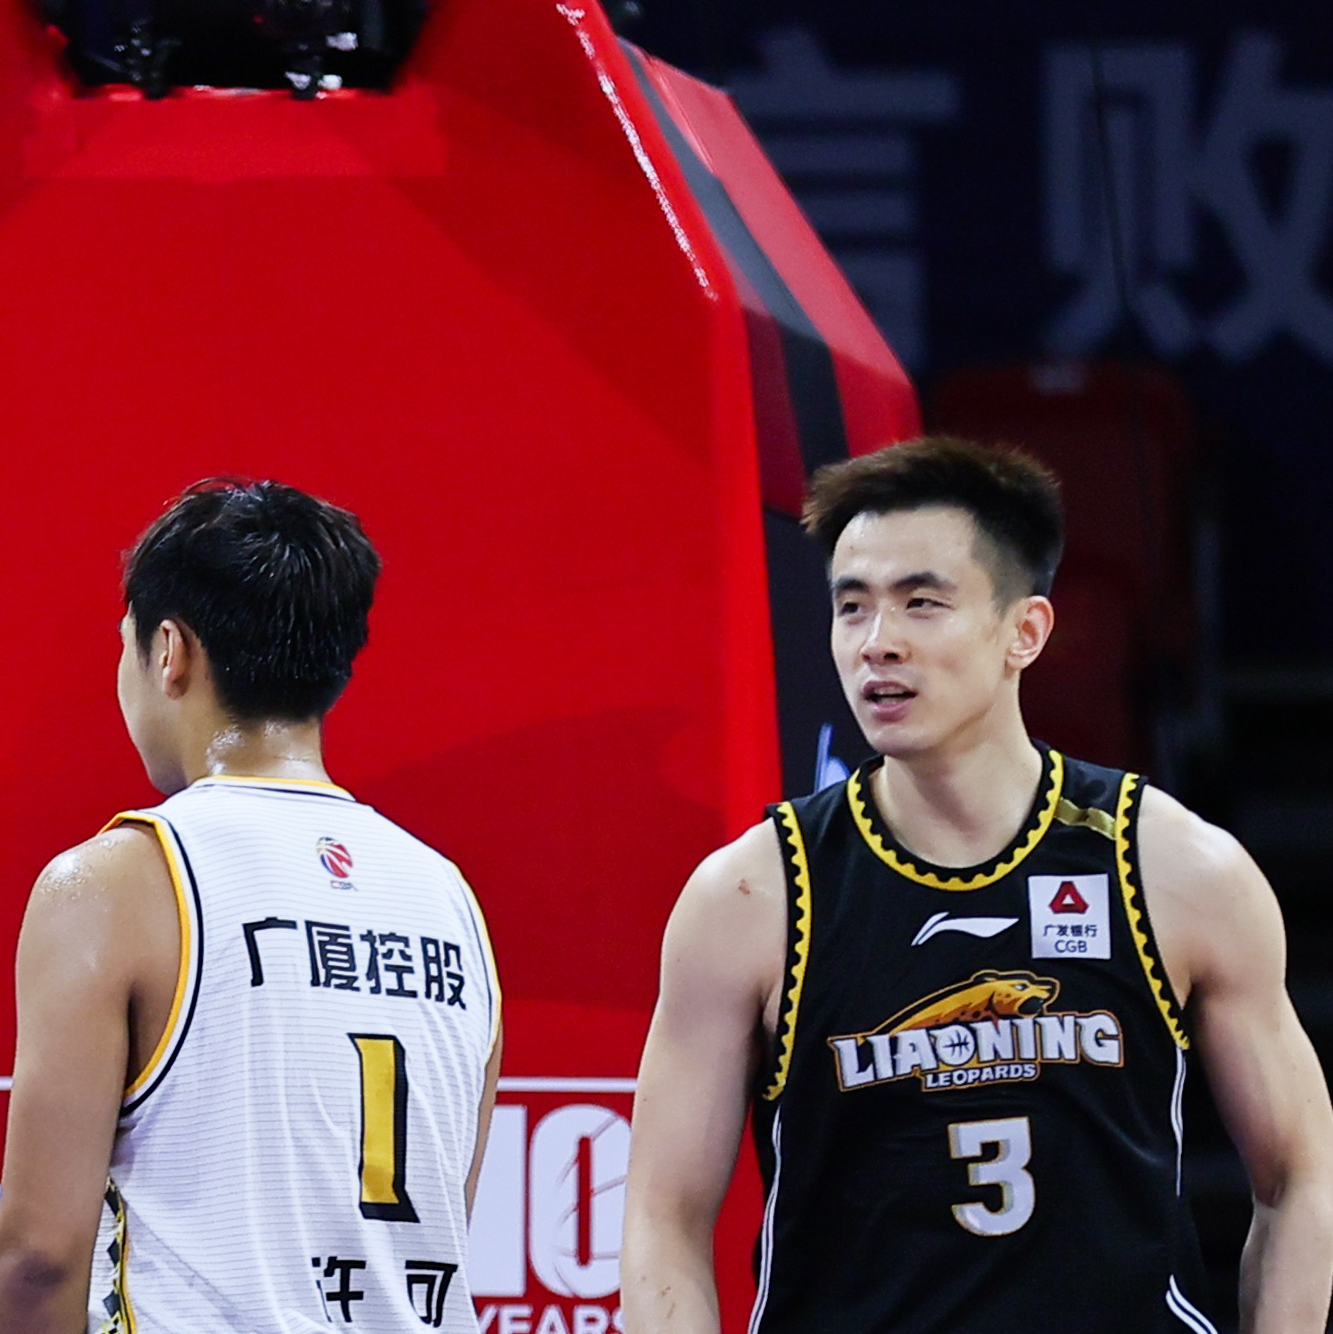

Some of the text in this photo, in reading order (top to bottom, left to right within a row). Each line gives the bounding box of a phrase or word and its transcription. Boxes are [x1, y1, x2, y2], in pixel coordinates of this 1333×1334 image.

[242, 917, 467, 1010] 广厦控股
[1054, 939, 1088, 954] CGB
[833, 1012, 1123, 1089] LIAONING
[926, 1063, 1038, 1088] LEOPARDS
[347, 1033, 421, 1224] 1
[947, 1116, 1036, 1237] 3
